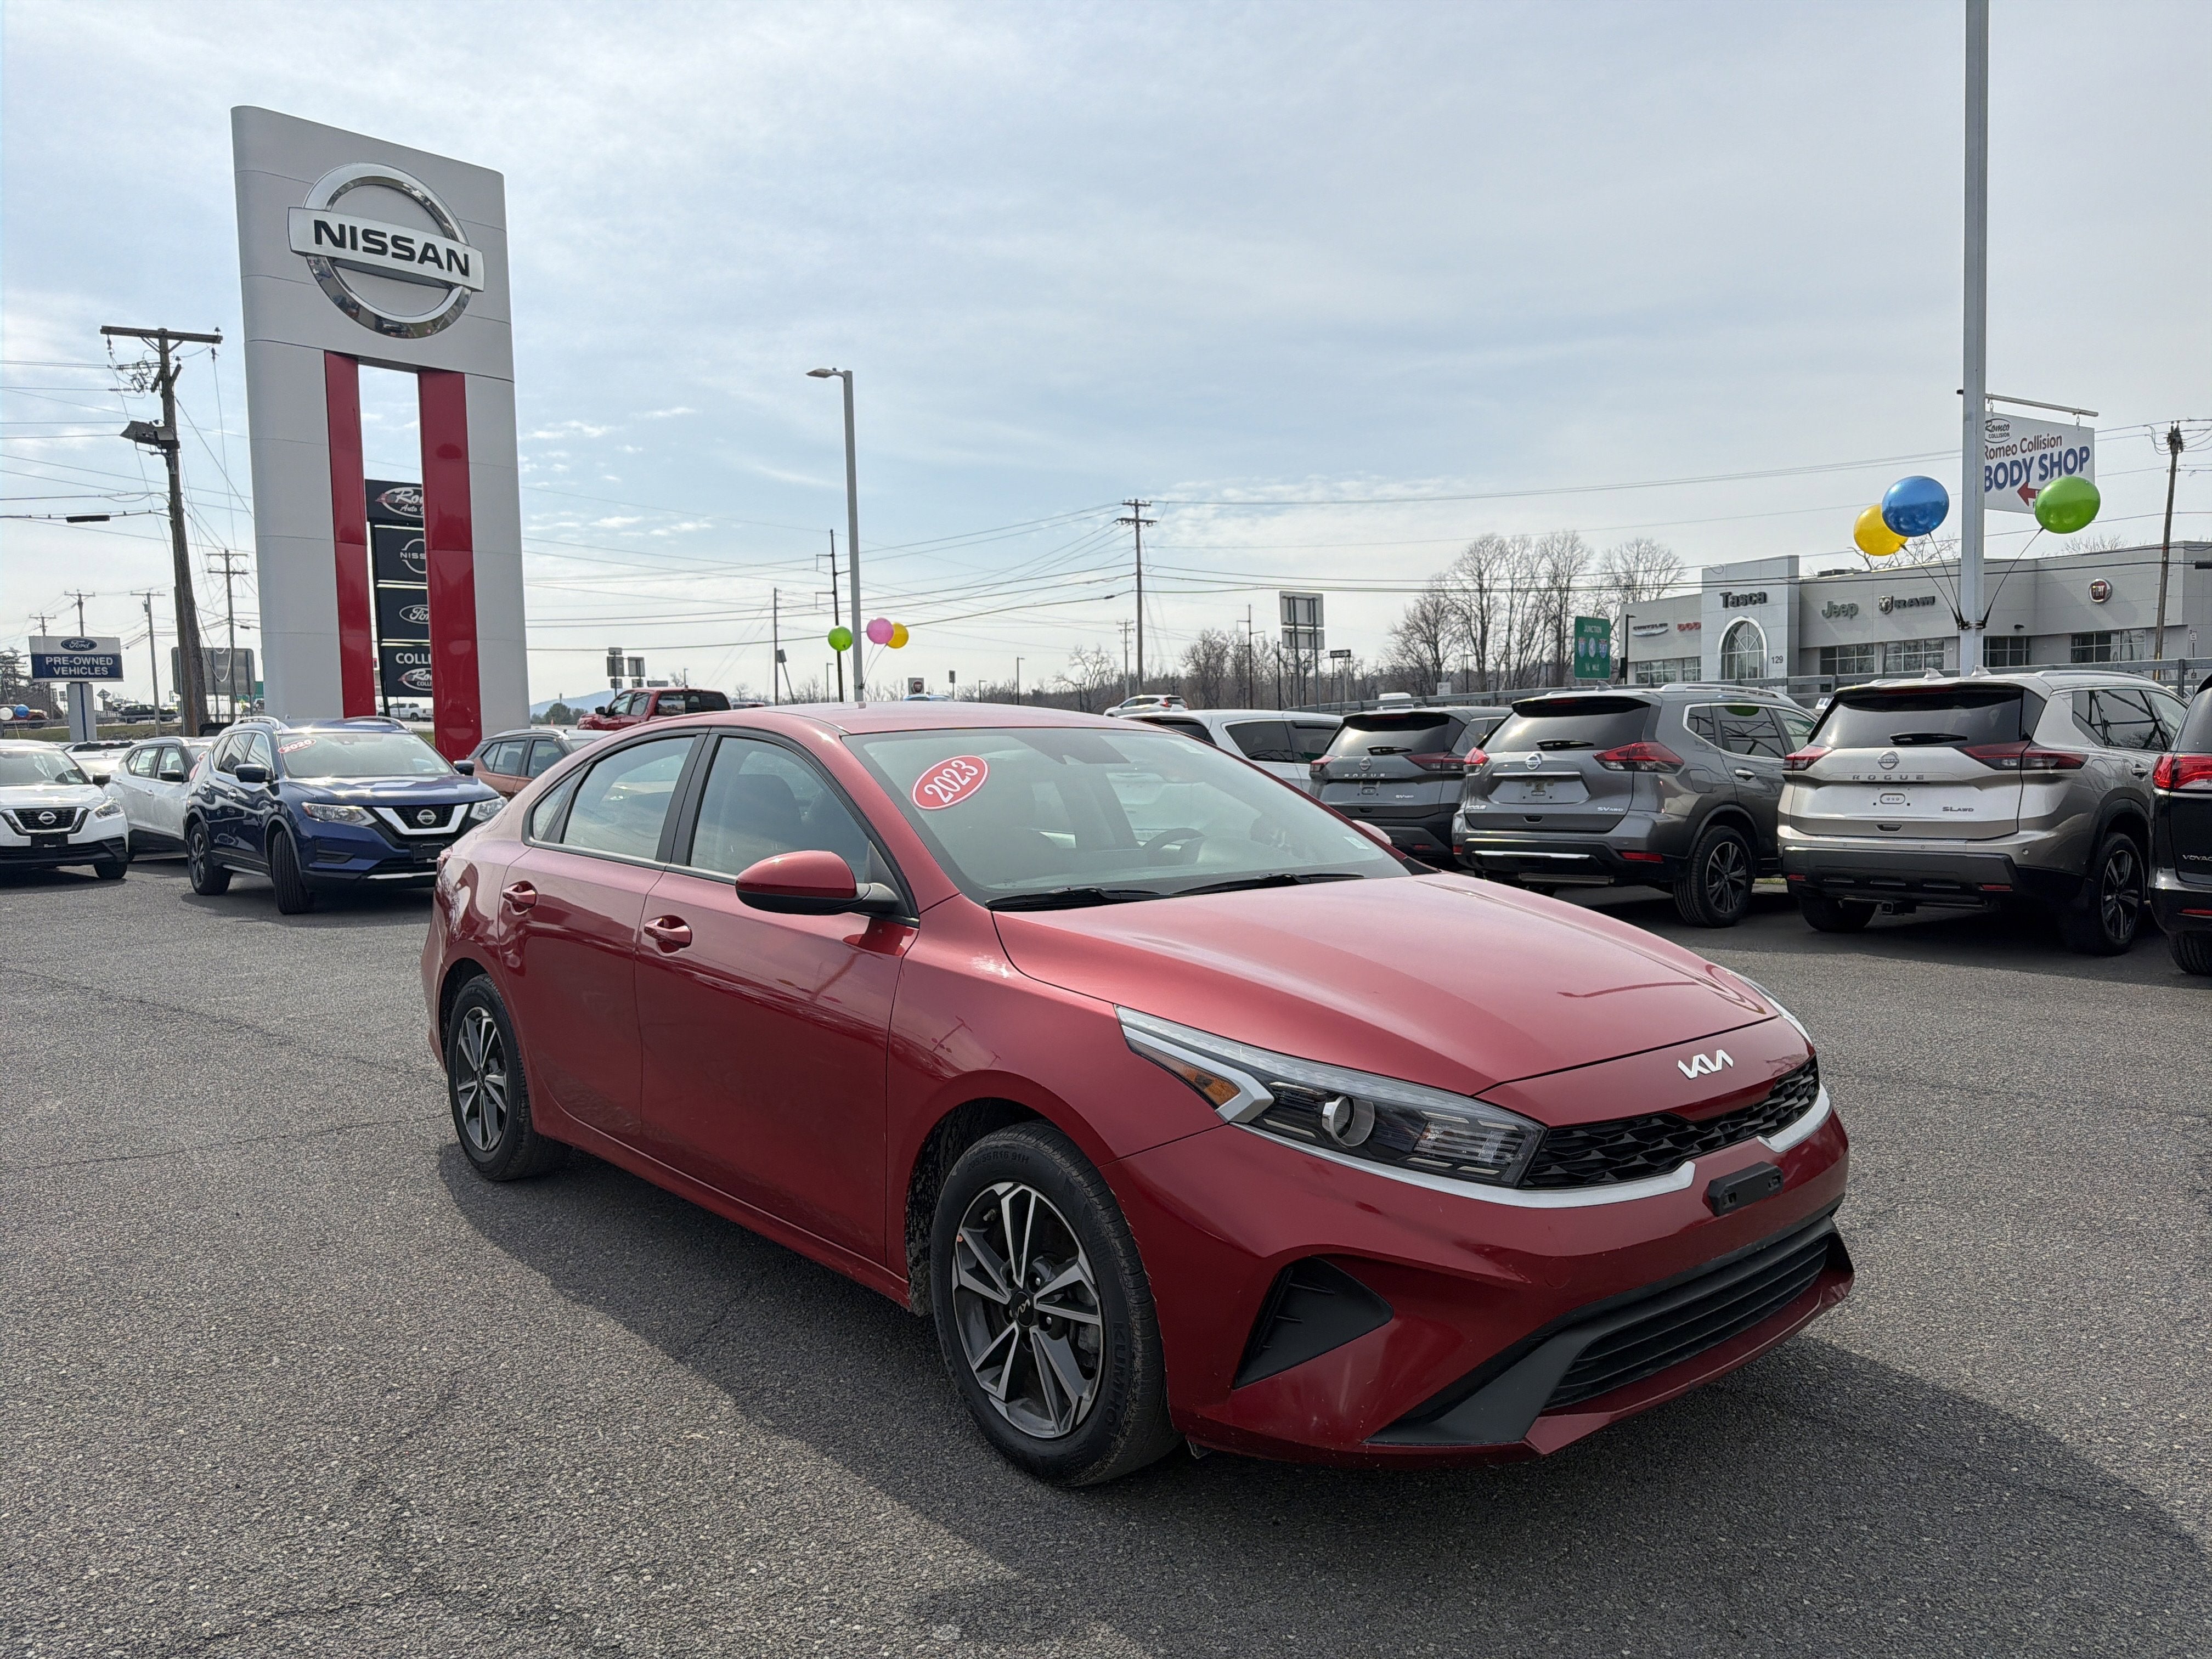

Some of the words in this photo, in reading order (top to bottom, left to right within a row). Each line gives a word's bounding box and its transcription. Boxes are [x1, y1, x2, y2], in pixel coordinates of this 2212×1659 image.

[314, 219, 470, 278] NISSAN
[1985, 420, 2010, 433] Romeo
[1984, 443, 2017, 460] Romeo
[2019, 433, 2062, 454] Collision
[1984, 456, 2035, 493] BODY
[2038, 446, 2090, 482] SHOP
[400, 504, 417, 512] Auto
[399, 551, 426, 560] NISS
[1719, 591, 1767, 608] Tasca
[1894, 596, 1936, 610] RAM
[1821, 601, 1859, 619] Jeep
[1677, 622, 1701, 631] DOD
[69, 640, 90, 648] Ford
[45, 656, 113, 665] PRE-OWNED
[396, 652, 431, 664] COLLI
[1771, 655, 1784, 664] 129
[53, 666, 109, 675] VEHICLES
[283, 739, 312, 753] 2020
[924, 760, 978, 803] 2023
[1678, 1049, 1734, 1079] KIA
